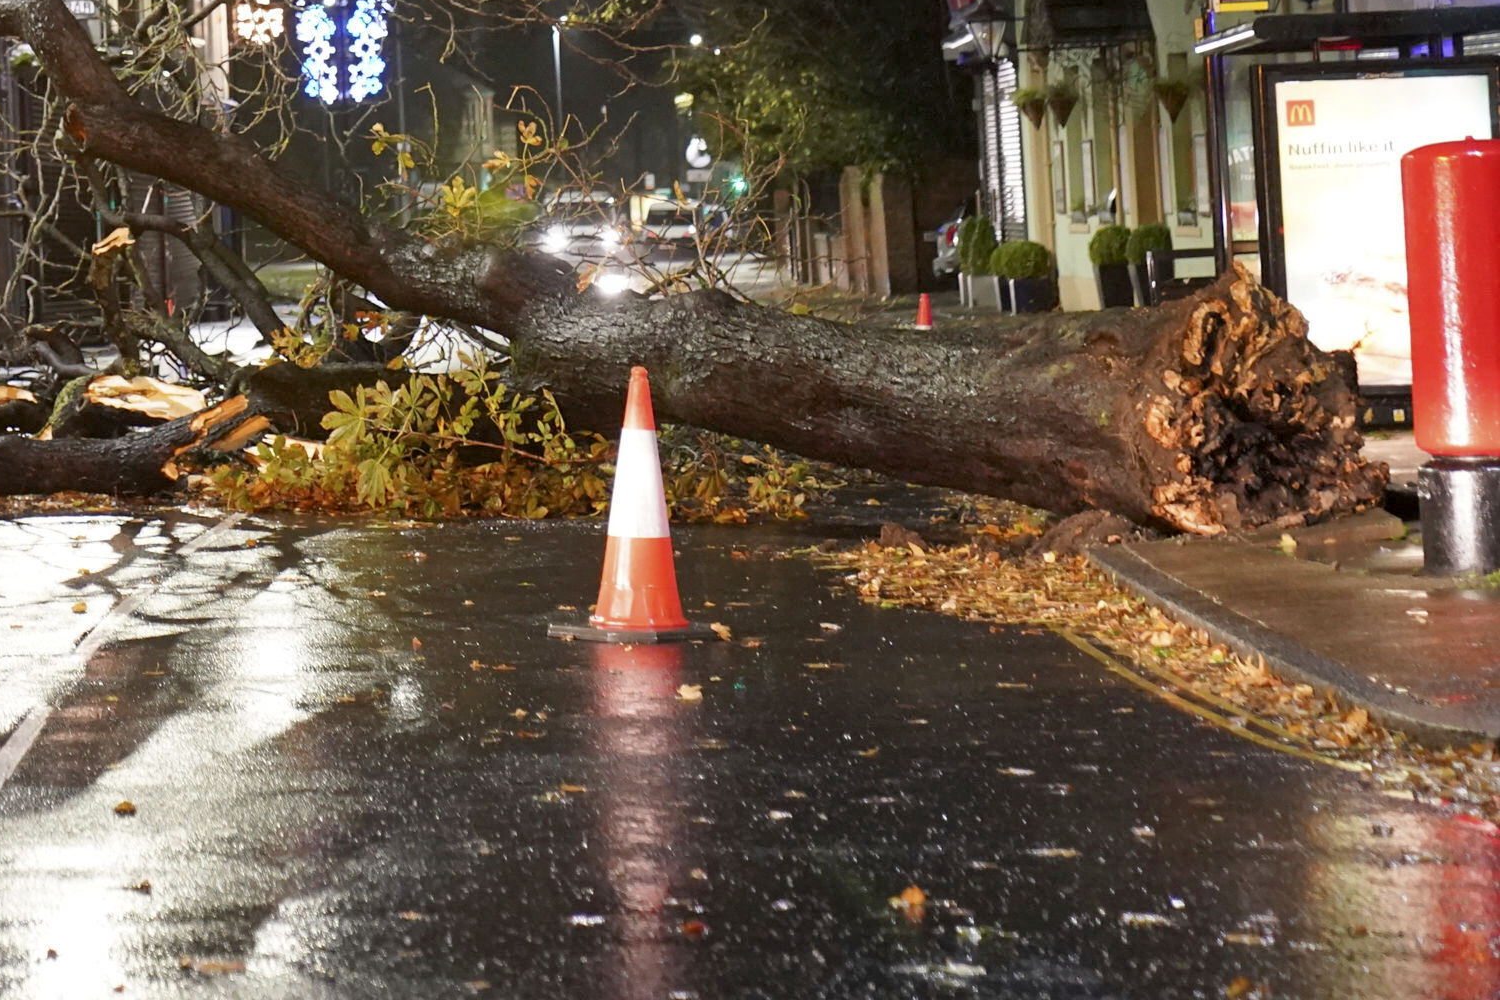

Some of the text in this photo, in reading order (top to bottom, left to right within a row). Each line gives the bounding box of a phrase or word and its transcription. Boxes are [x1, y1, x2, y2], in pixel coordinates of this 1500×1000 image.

[1288, 140, 1394, 156] Nuffin like it
